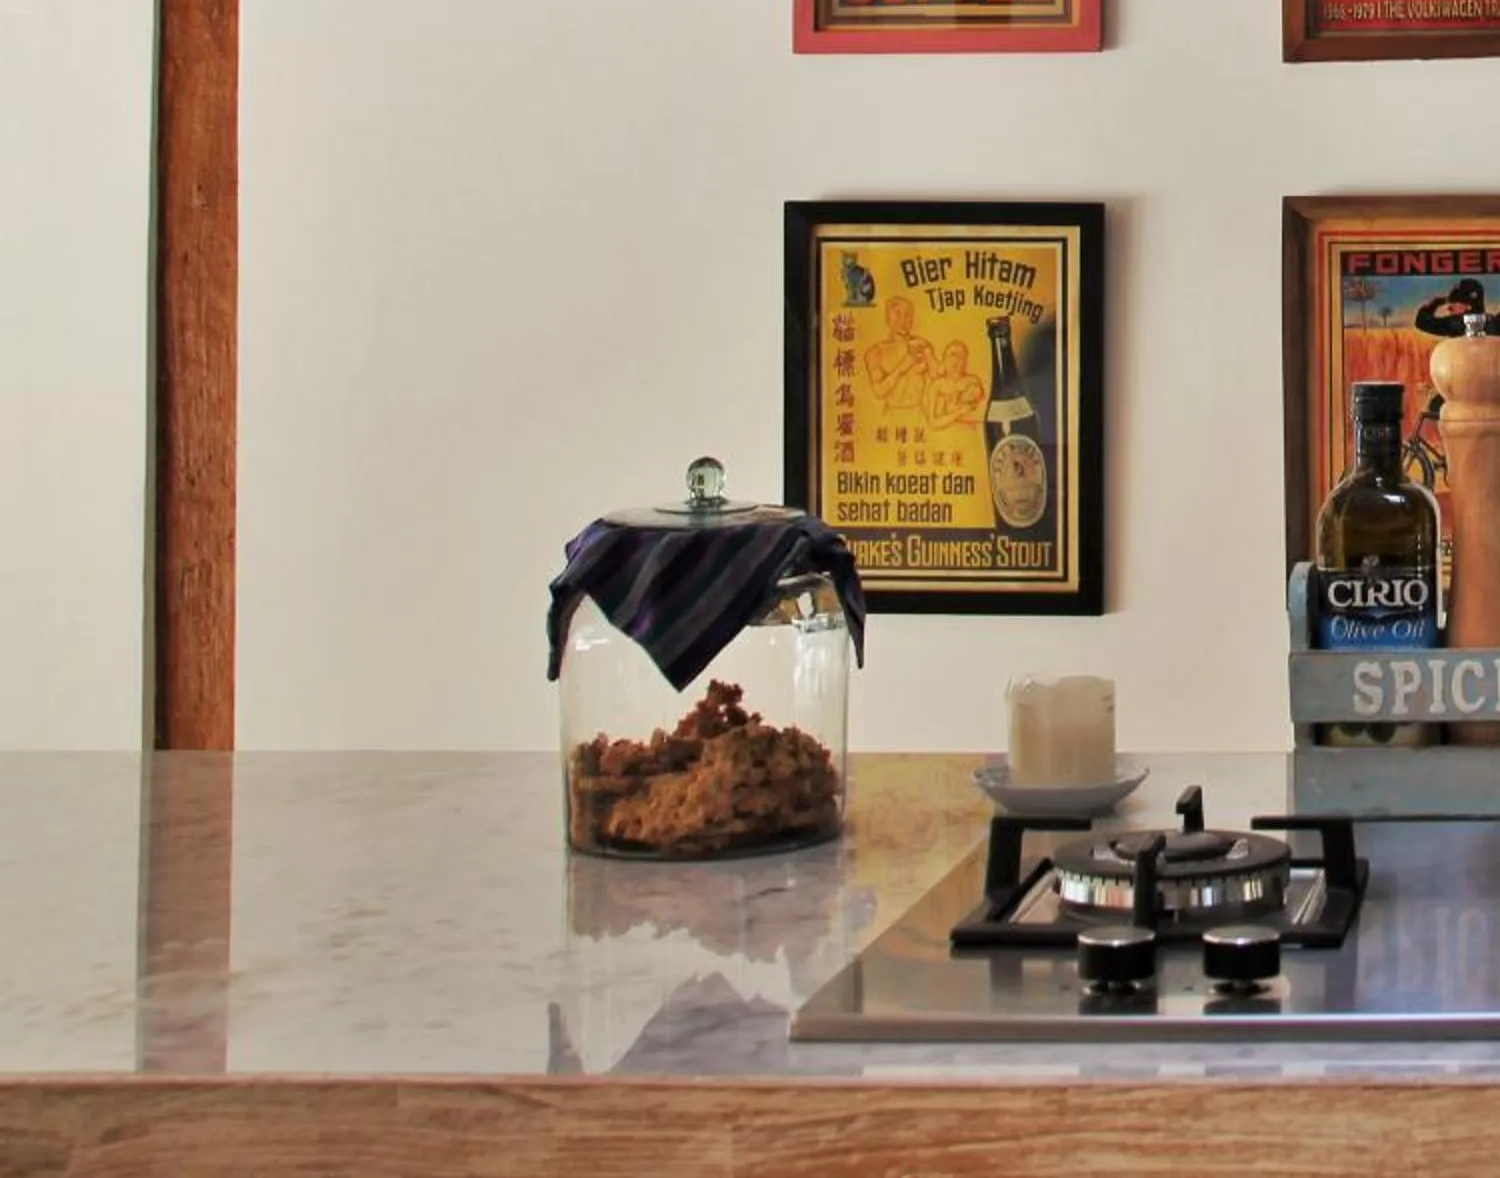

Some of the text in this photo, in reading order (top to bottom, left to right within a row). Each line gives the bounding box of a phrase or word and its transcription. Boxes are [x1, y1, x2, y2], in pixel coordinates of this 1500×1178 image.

[1383, 0, 1407, 19] THE
[900, 250, 1037, 289] Bier Hitam
[924, 285, 1044, 324] Tjap Koetjing
[837, 471, 975, 495] Bikin koeat dan
[837, 499, 952, 522] sehat badan
[837, 531, 904, 567] AKE'S
[1327, 579, 1429, 607] CIRIO
[1331, 615, 1426, 640] Olive Oil
